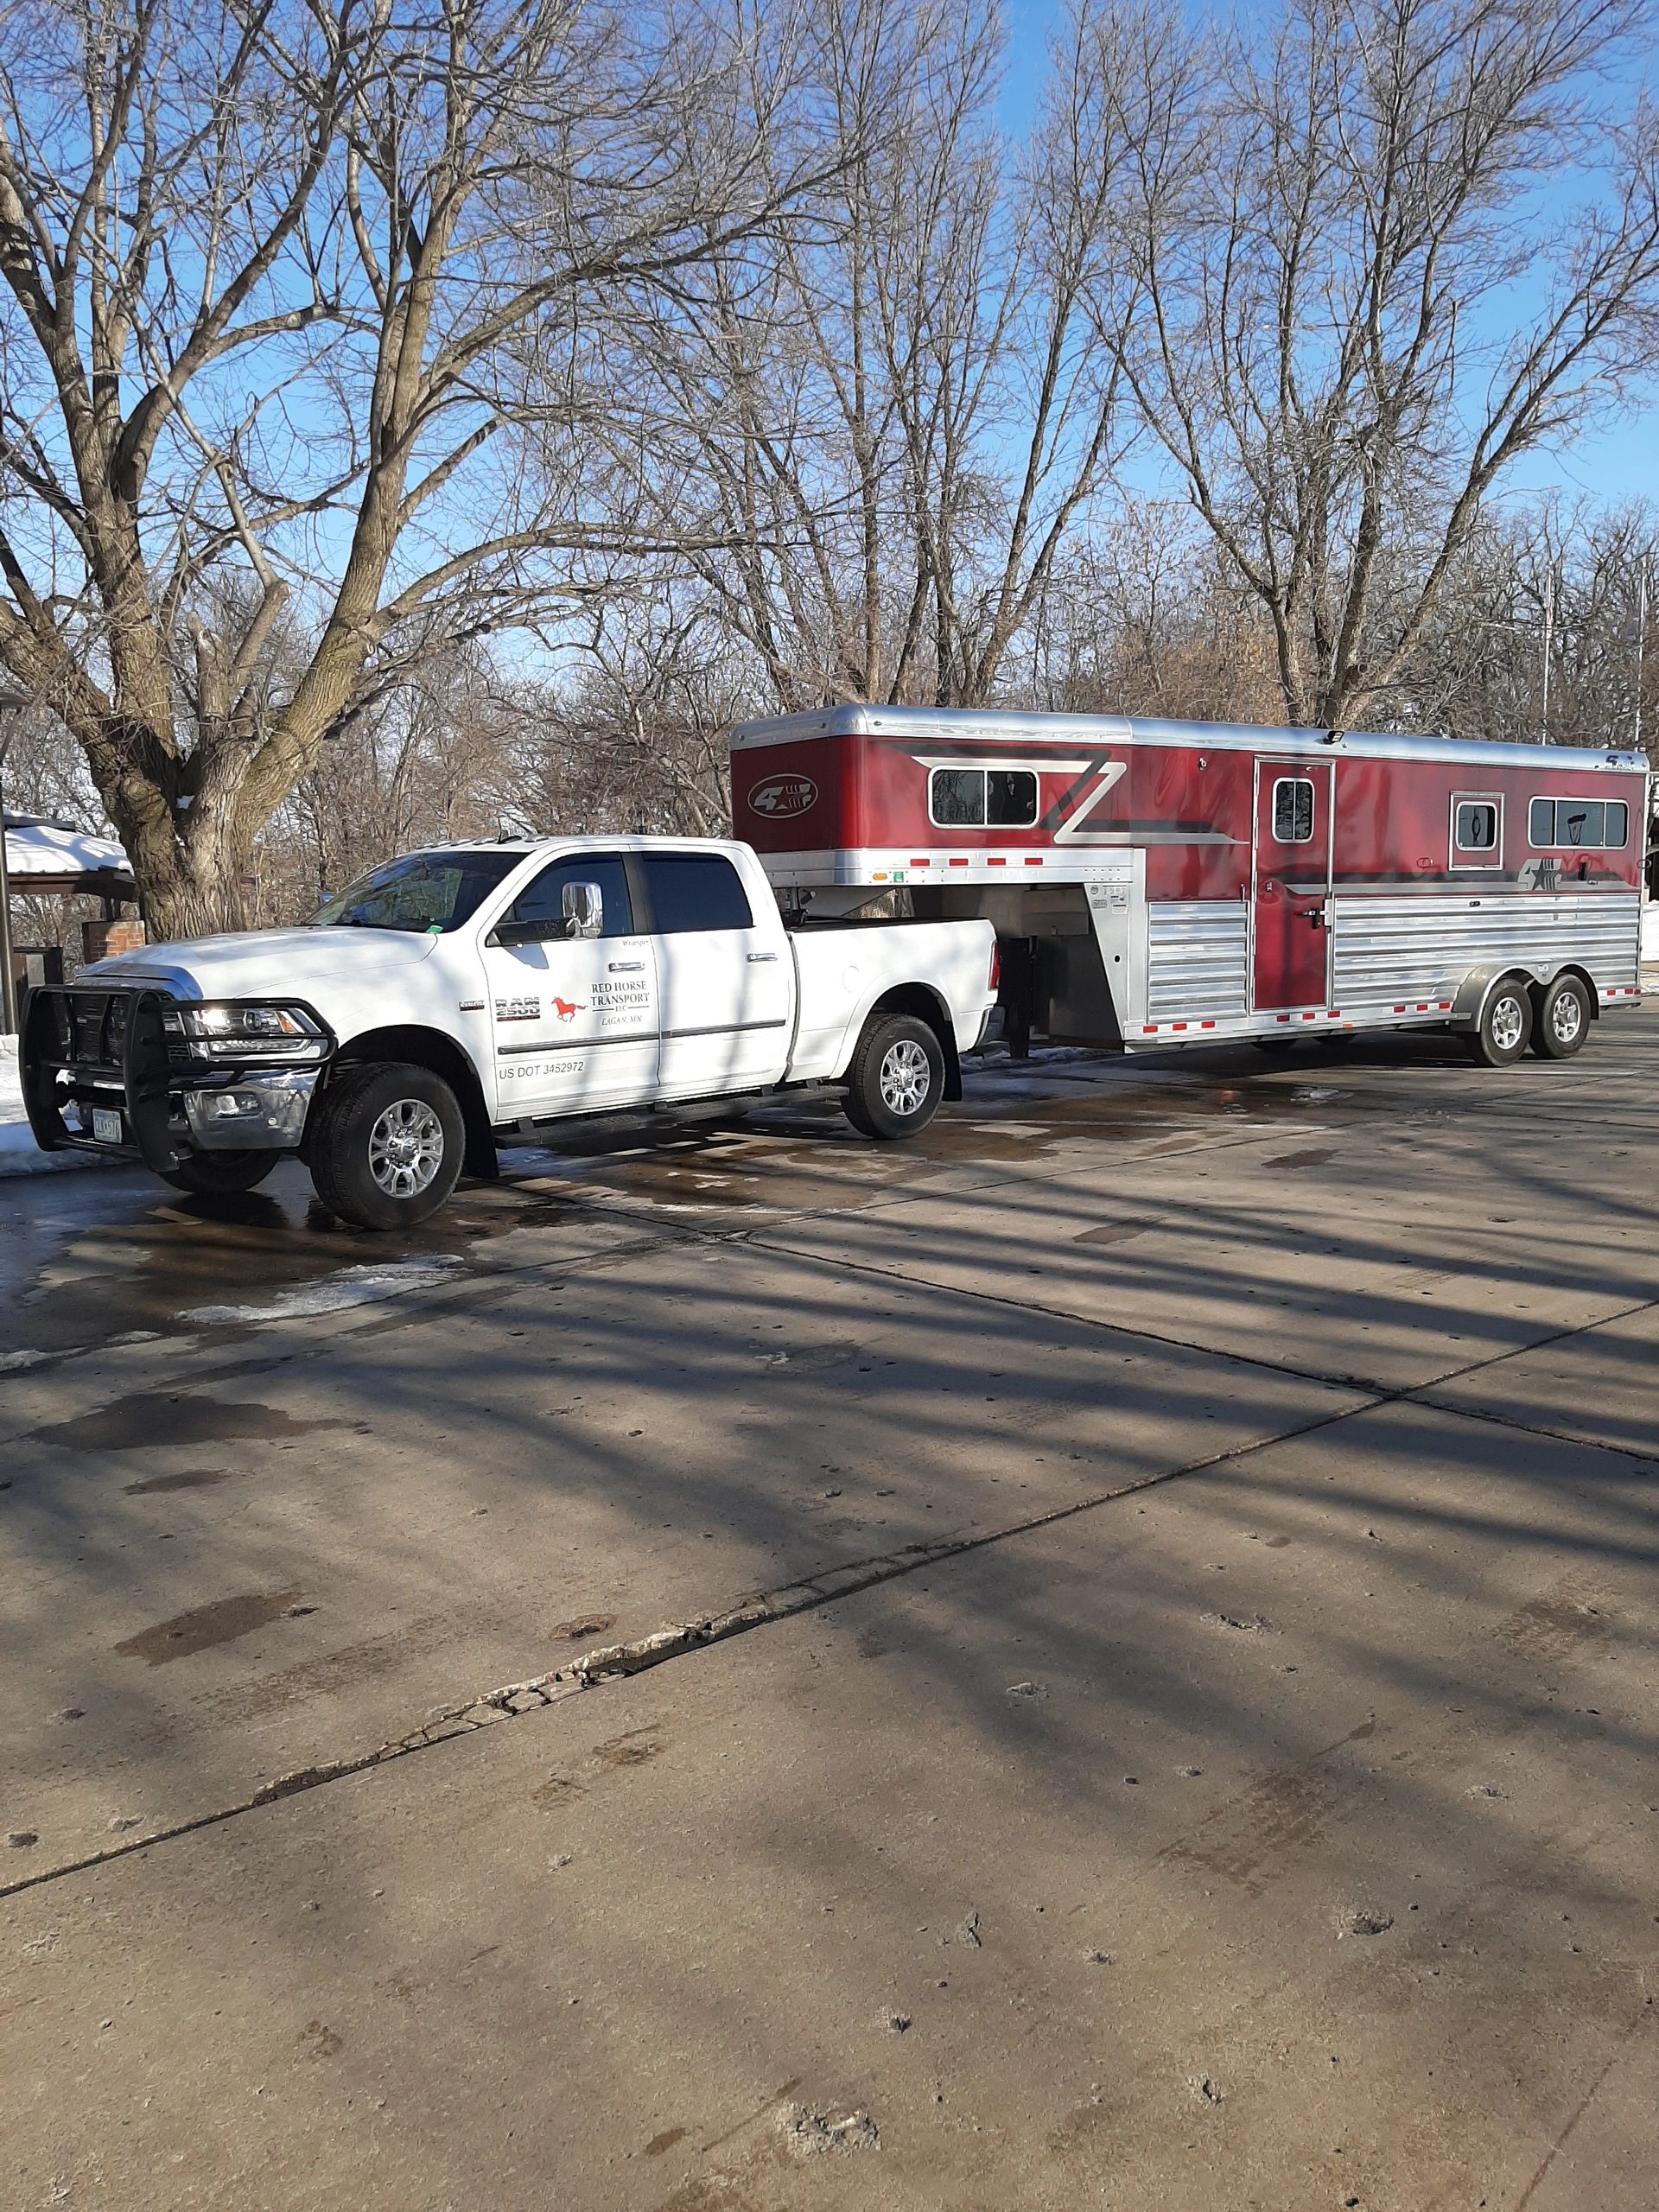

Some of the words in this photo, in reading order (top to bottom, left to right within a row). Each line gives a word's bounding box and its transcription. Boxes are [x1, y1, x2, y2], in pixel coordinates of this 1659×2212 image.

[592, 983, 612, 993] RED
[614, 981, 646, 991] HORSE
[495, 997, 540, 1007] RAM
[590, 993, 650, 1006] TRANSPORT
[496, 1006, 541, 1016] 2500
[499, 1068, 514, 1079] US
[518, 1065, 540, 1077] DOT
[543, 1062, 584, 1074] 3452972
